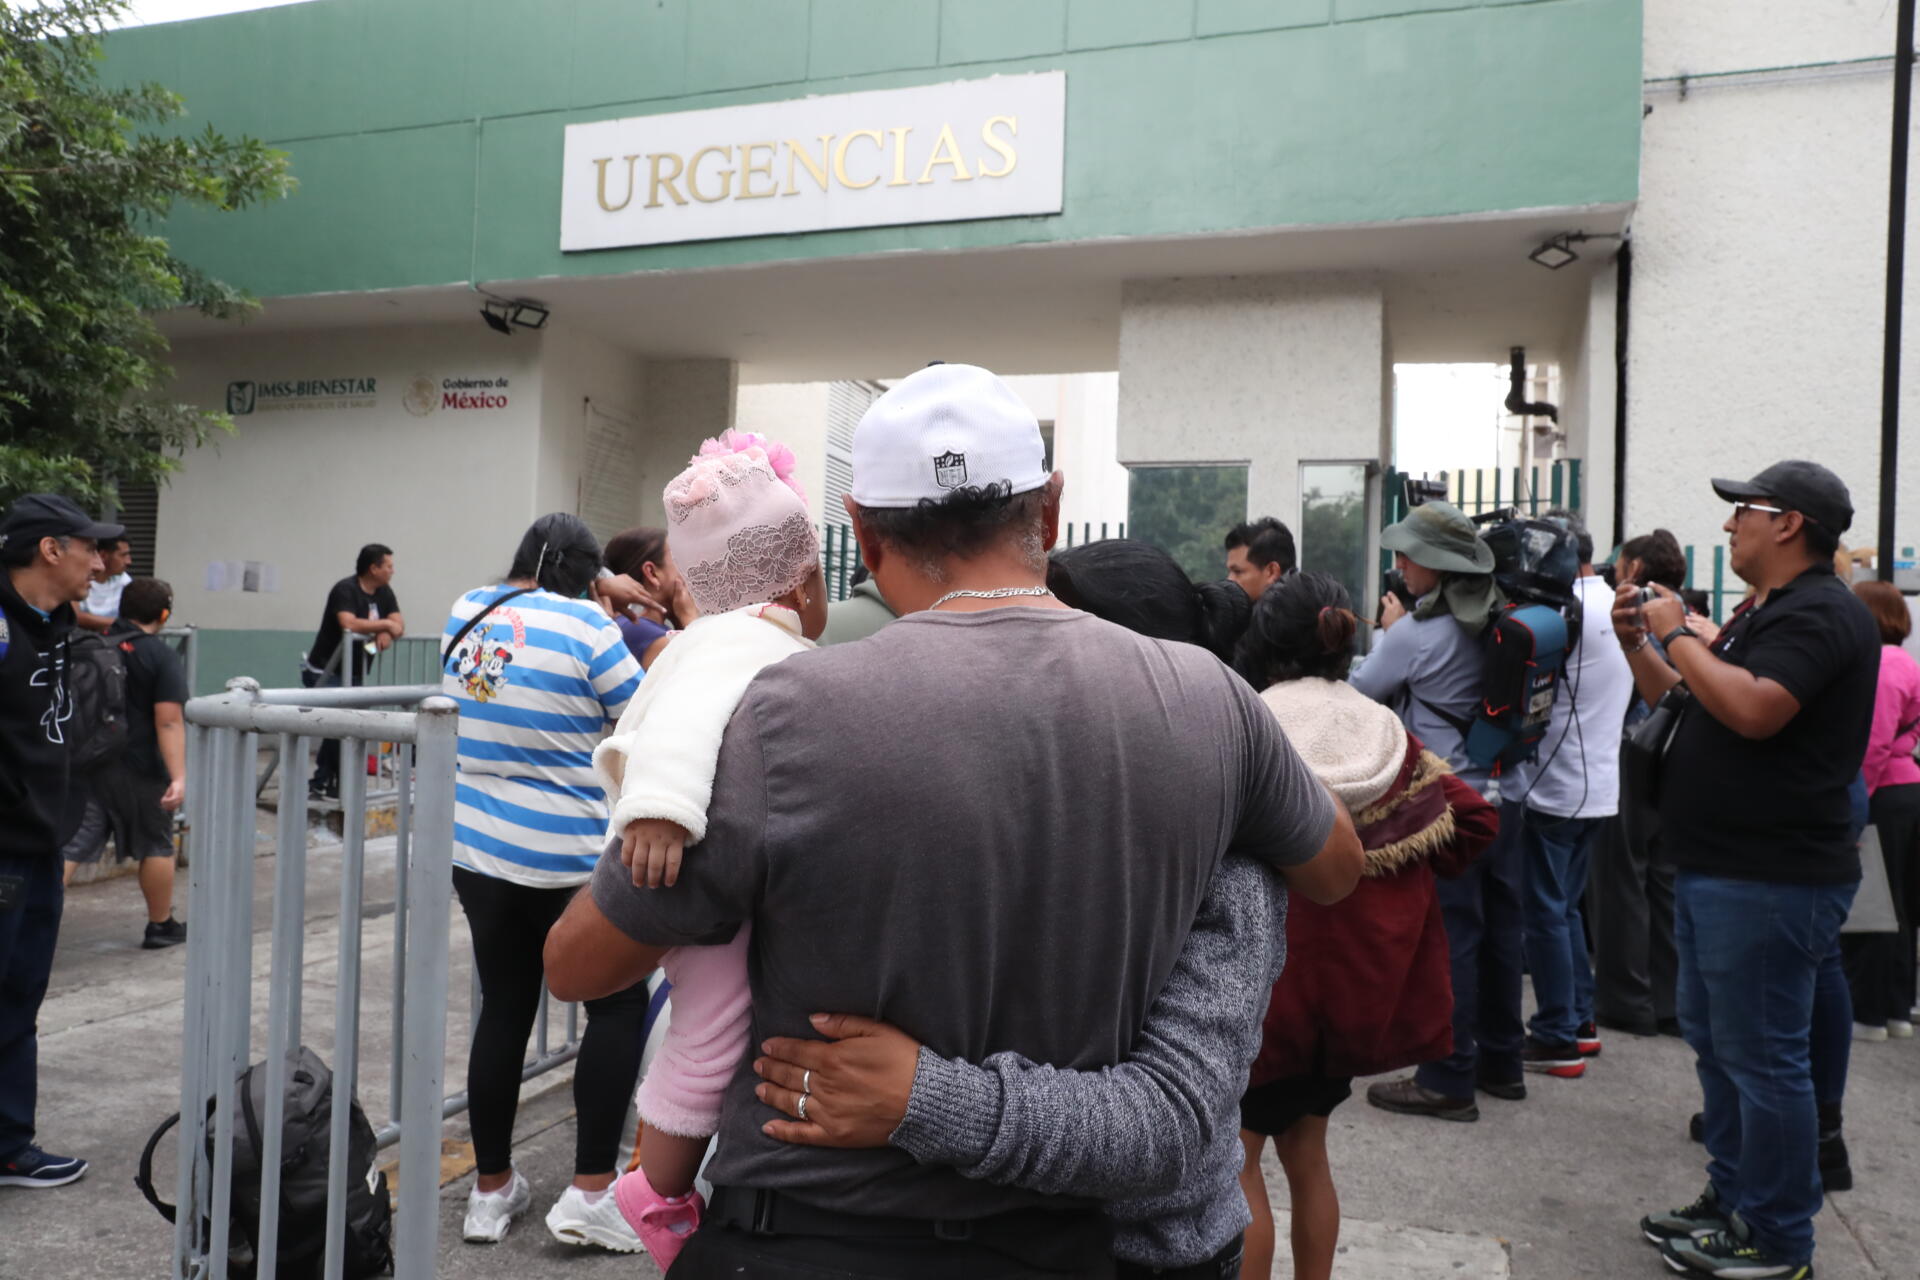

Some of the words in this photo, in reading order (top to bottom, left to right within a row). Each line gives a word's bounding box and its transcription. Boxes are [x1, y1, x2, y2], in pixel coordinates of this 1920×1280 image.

[592, 115, 1018, 213] URGENCIAS
[257, 378, 376, 398] IMSS-BIENESTAR
[442, 378, 493, 389] Gobierno
[495, 377, 508, 388] de
[441, 391, 508, 409] México
